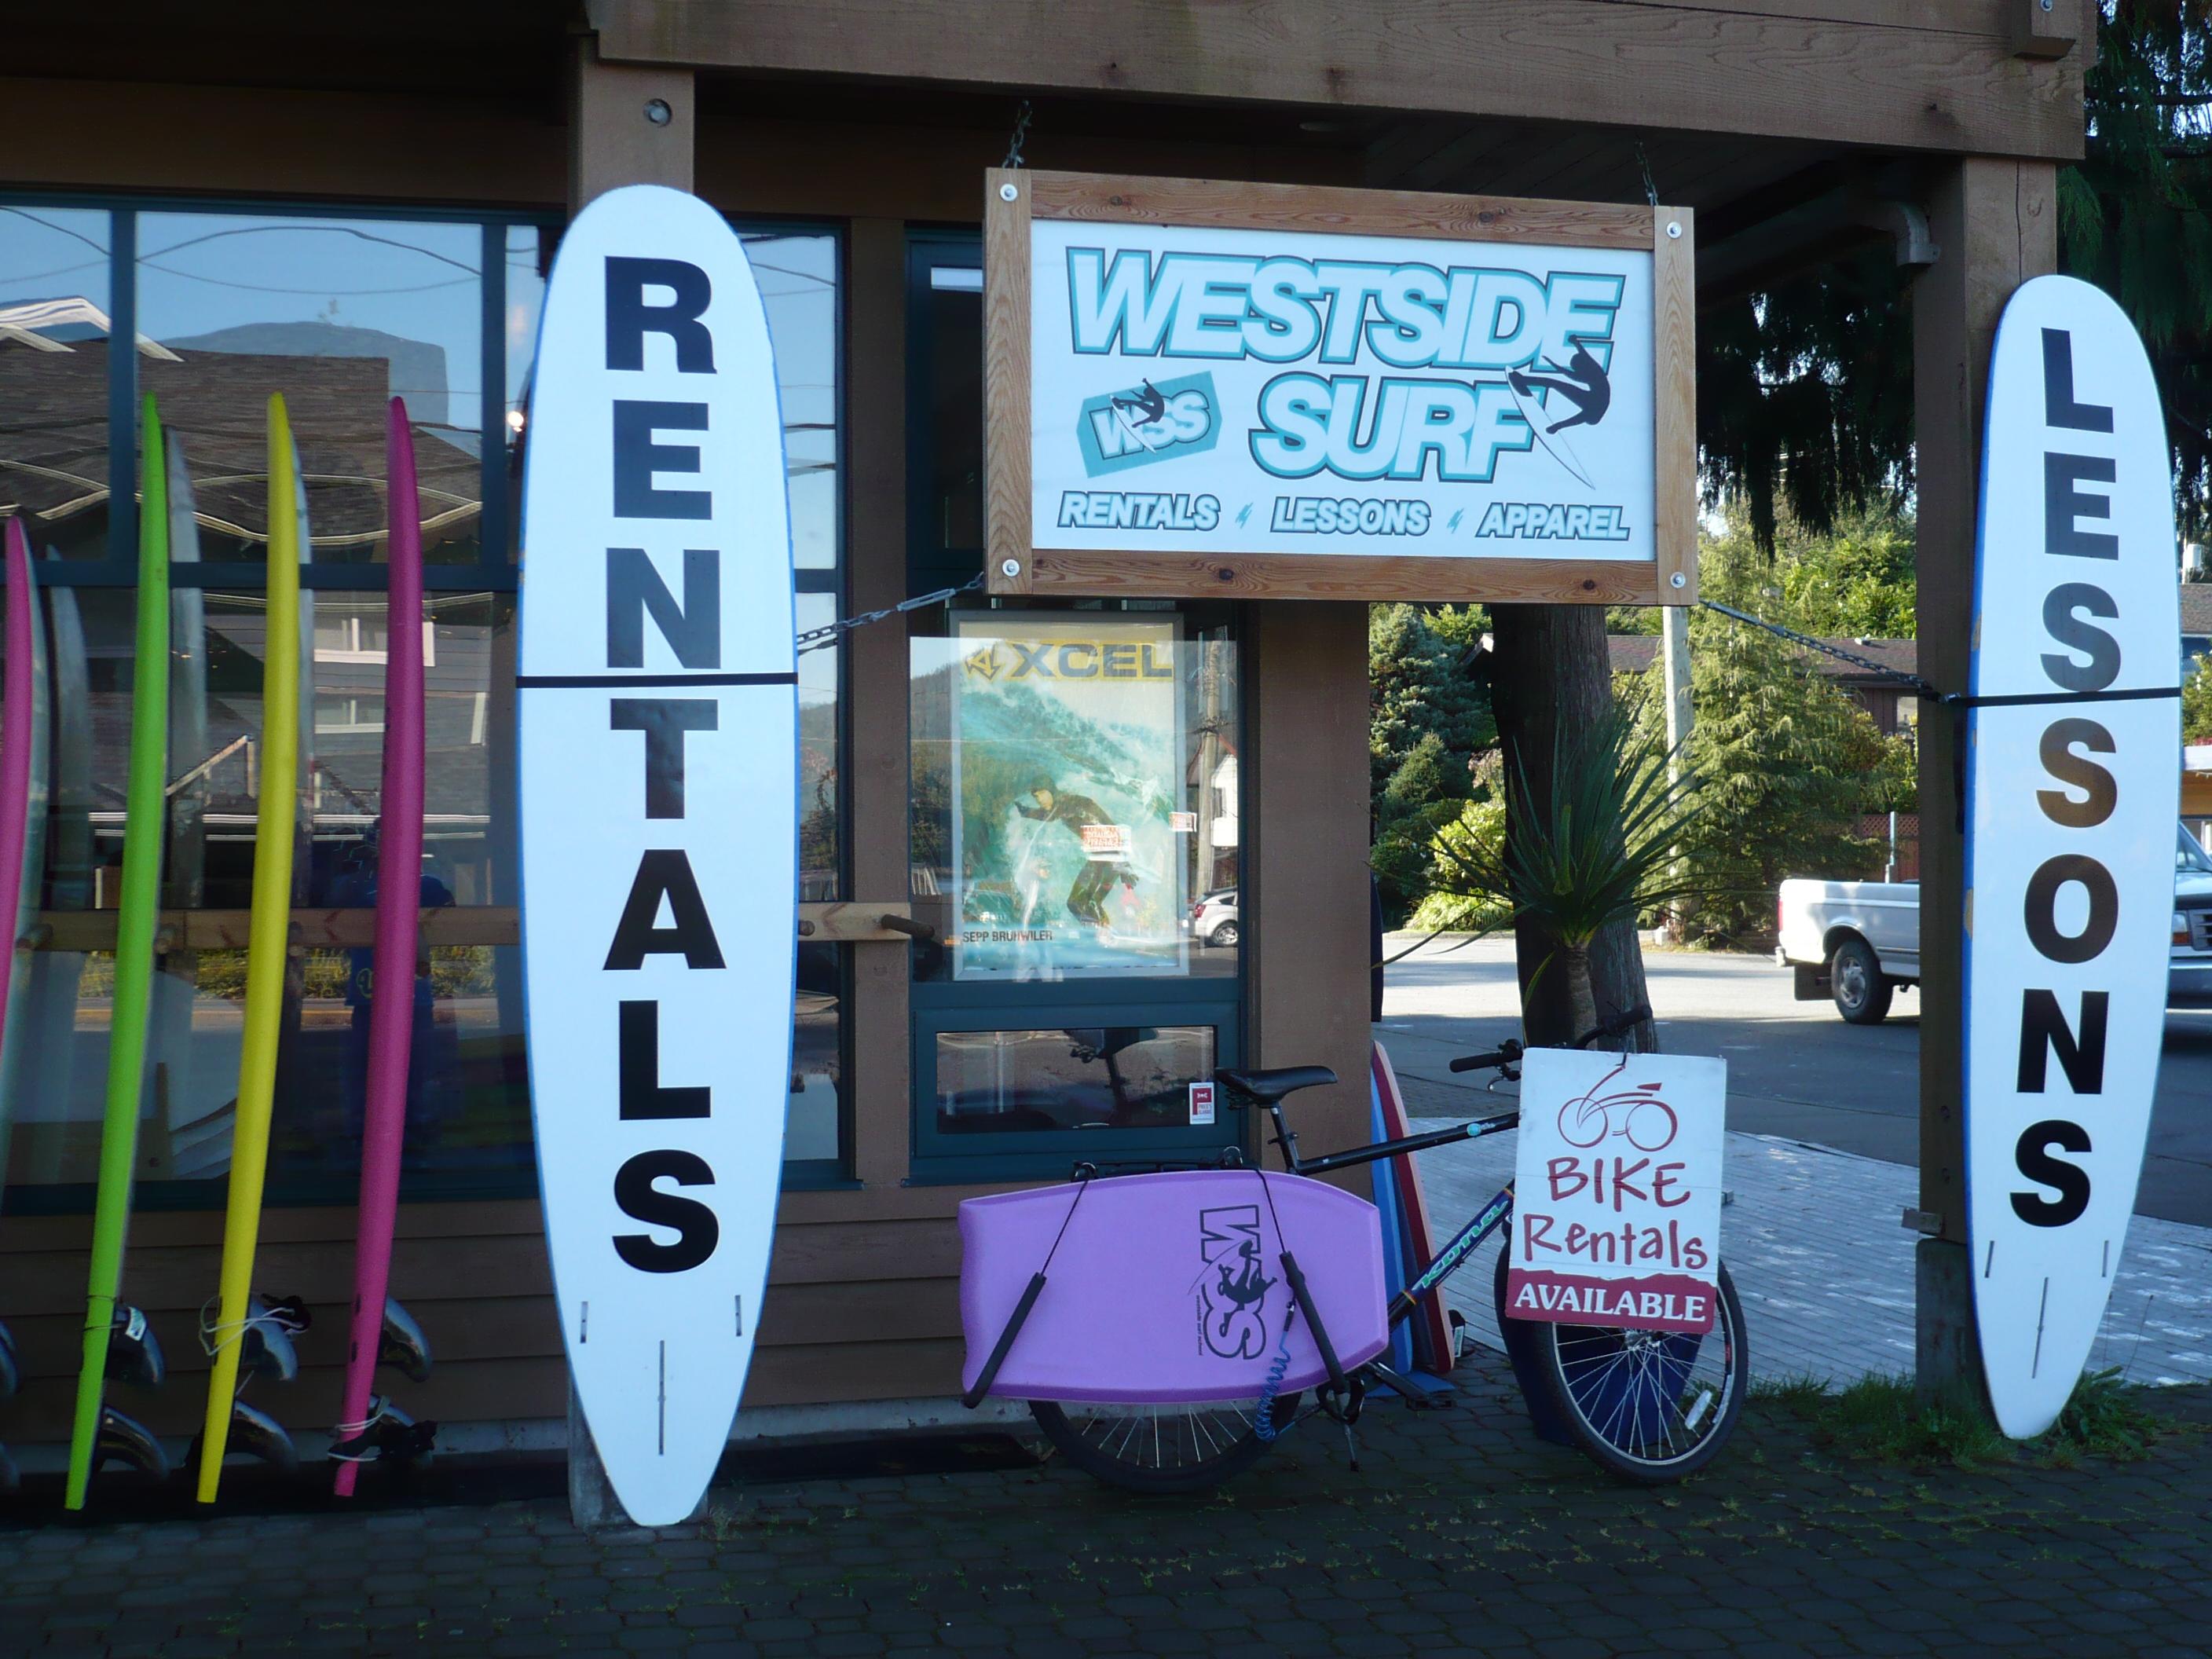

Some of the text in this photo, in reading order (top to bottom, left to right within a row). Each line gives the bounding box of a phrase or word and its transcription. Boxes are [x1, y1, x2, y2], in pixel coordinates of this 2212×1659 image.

[1066, 247, 1627, 372] WESTSIDE
[1089, 390, 1211, 460] WSS
[1248, 371, 1548, 483] SURF
[1057, 490, 1631, 541] RENTALS LESSONS APPAREL
[1006, 643, 1173, 679] XCEL
[602, 256, 727, 1273] RENTALS
[2010, 327, 2122, 1228] LESSONS
[963, 931, 990, 943] SEPP
[1547, 1156, 1690, 1212] BIKE
[1523, 1214, 1708, 1269] Rentals
[1514, 1283, 1706, 1322] AVAILABLE
